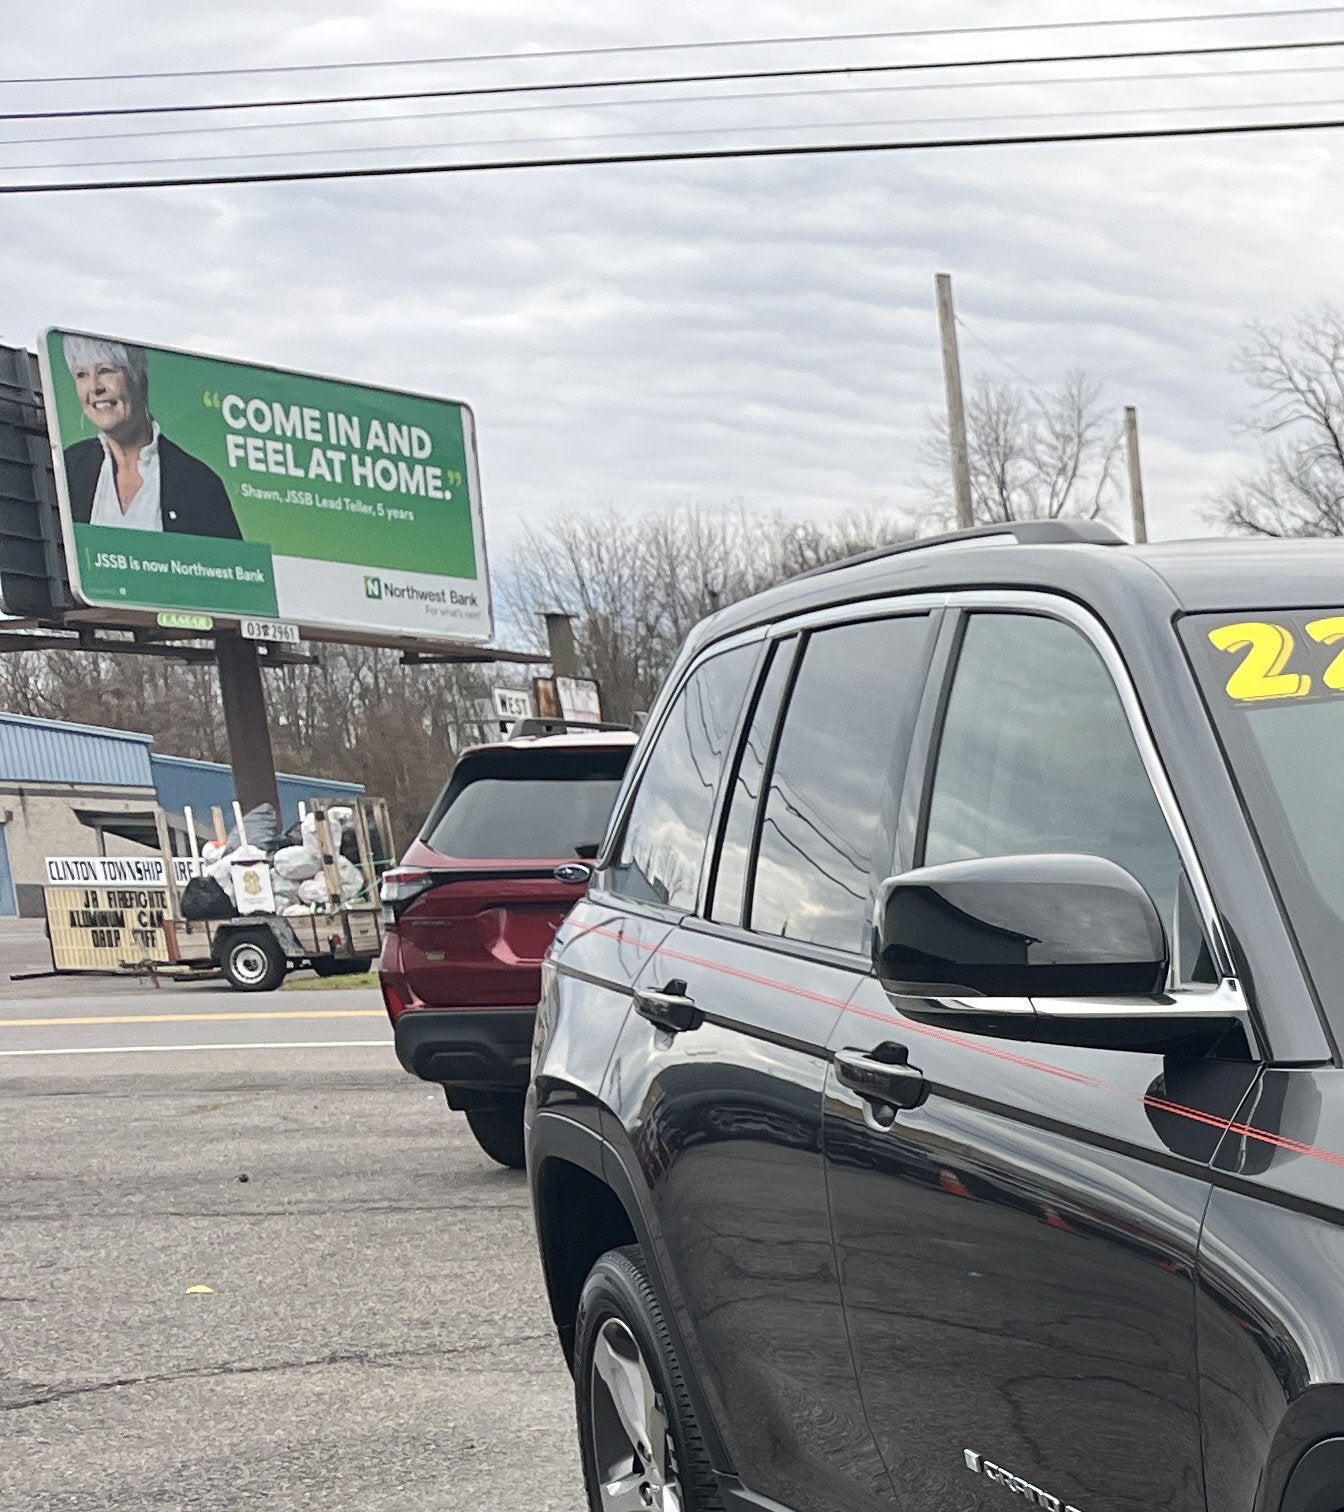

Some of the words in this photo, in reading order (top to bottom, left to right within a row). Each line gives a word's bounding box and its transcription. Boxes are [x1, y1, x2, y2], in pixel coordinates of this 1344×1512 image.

[327, 411, 361, 449] IN
[366, 418, 433, 460] AND
[225, 433, 305, 478] FEEL
[307, 447, 347, 483] AT
[315, 494, 342, 511] Lead
[386, 506, 415, 521] years
[94, 552, 127, 570] JSSB
[128, 555, 140, 572] is
[142, 561, 169, 574] now
[171, 560, 234, 580] Northwest
[235, 566, 266, 584] Bank
[384, 582, 447, 603] Northwest
[449, 589, 479, 607] Bank
[48, 860, 98, 881] CLINTON
[100, 860, 164, 881] TOWNSHIP
[91, 929, 120, 948] DROP
